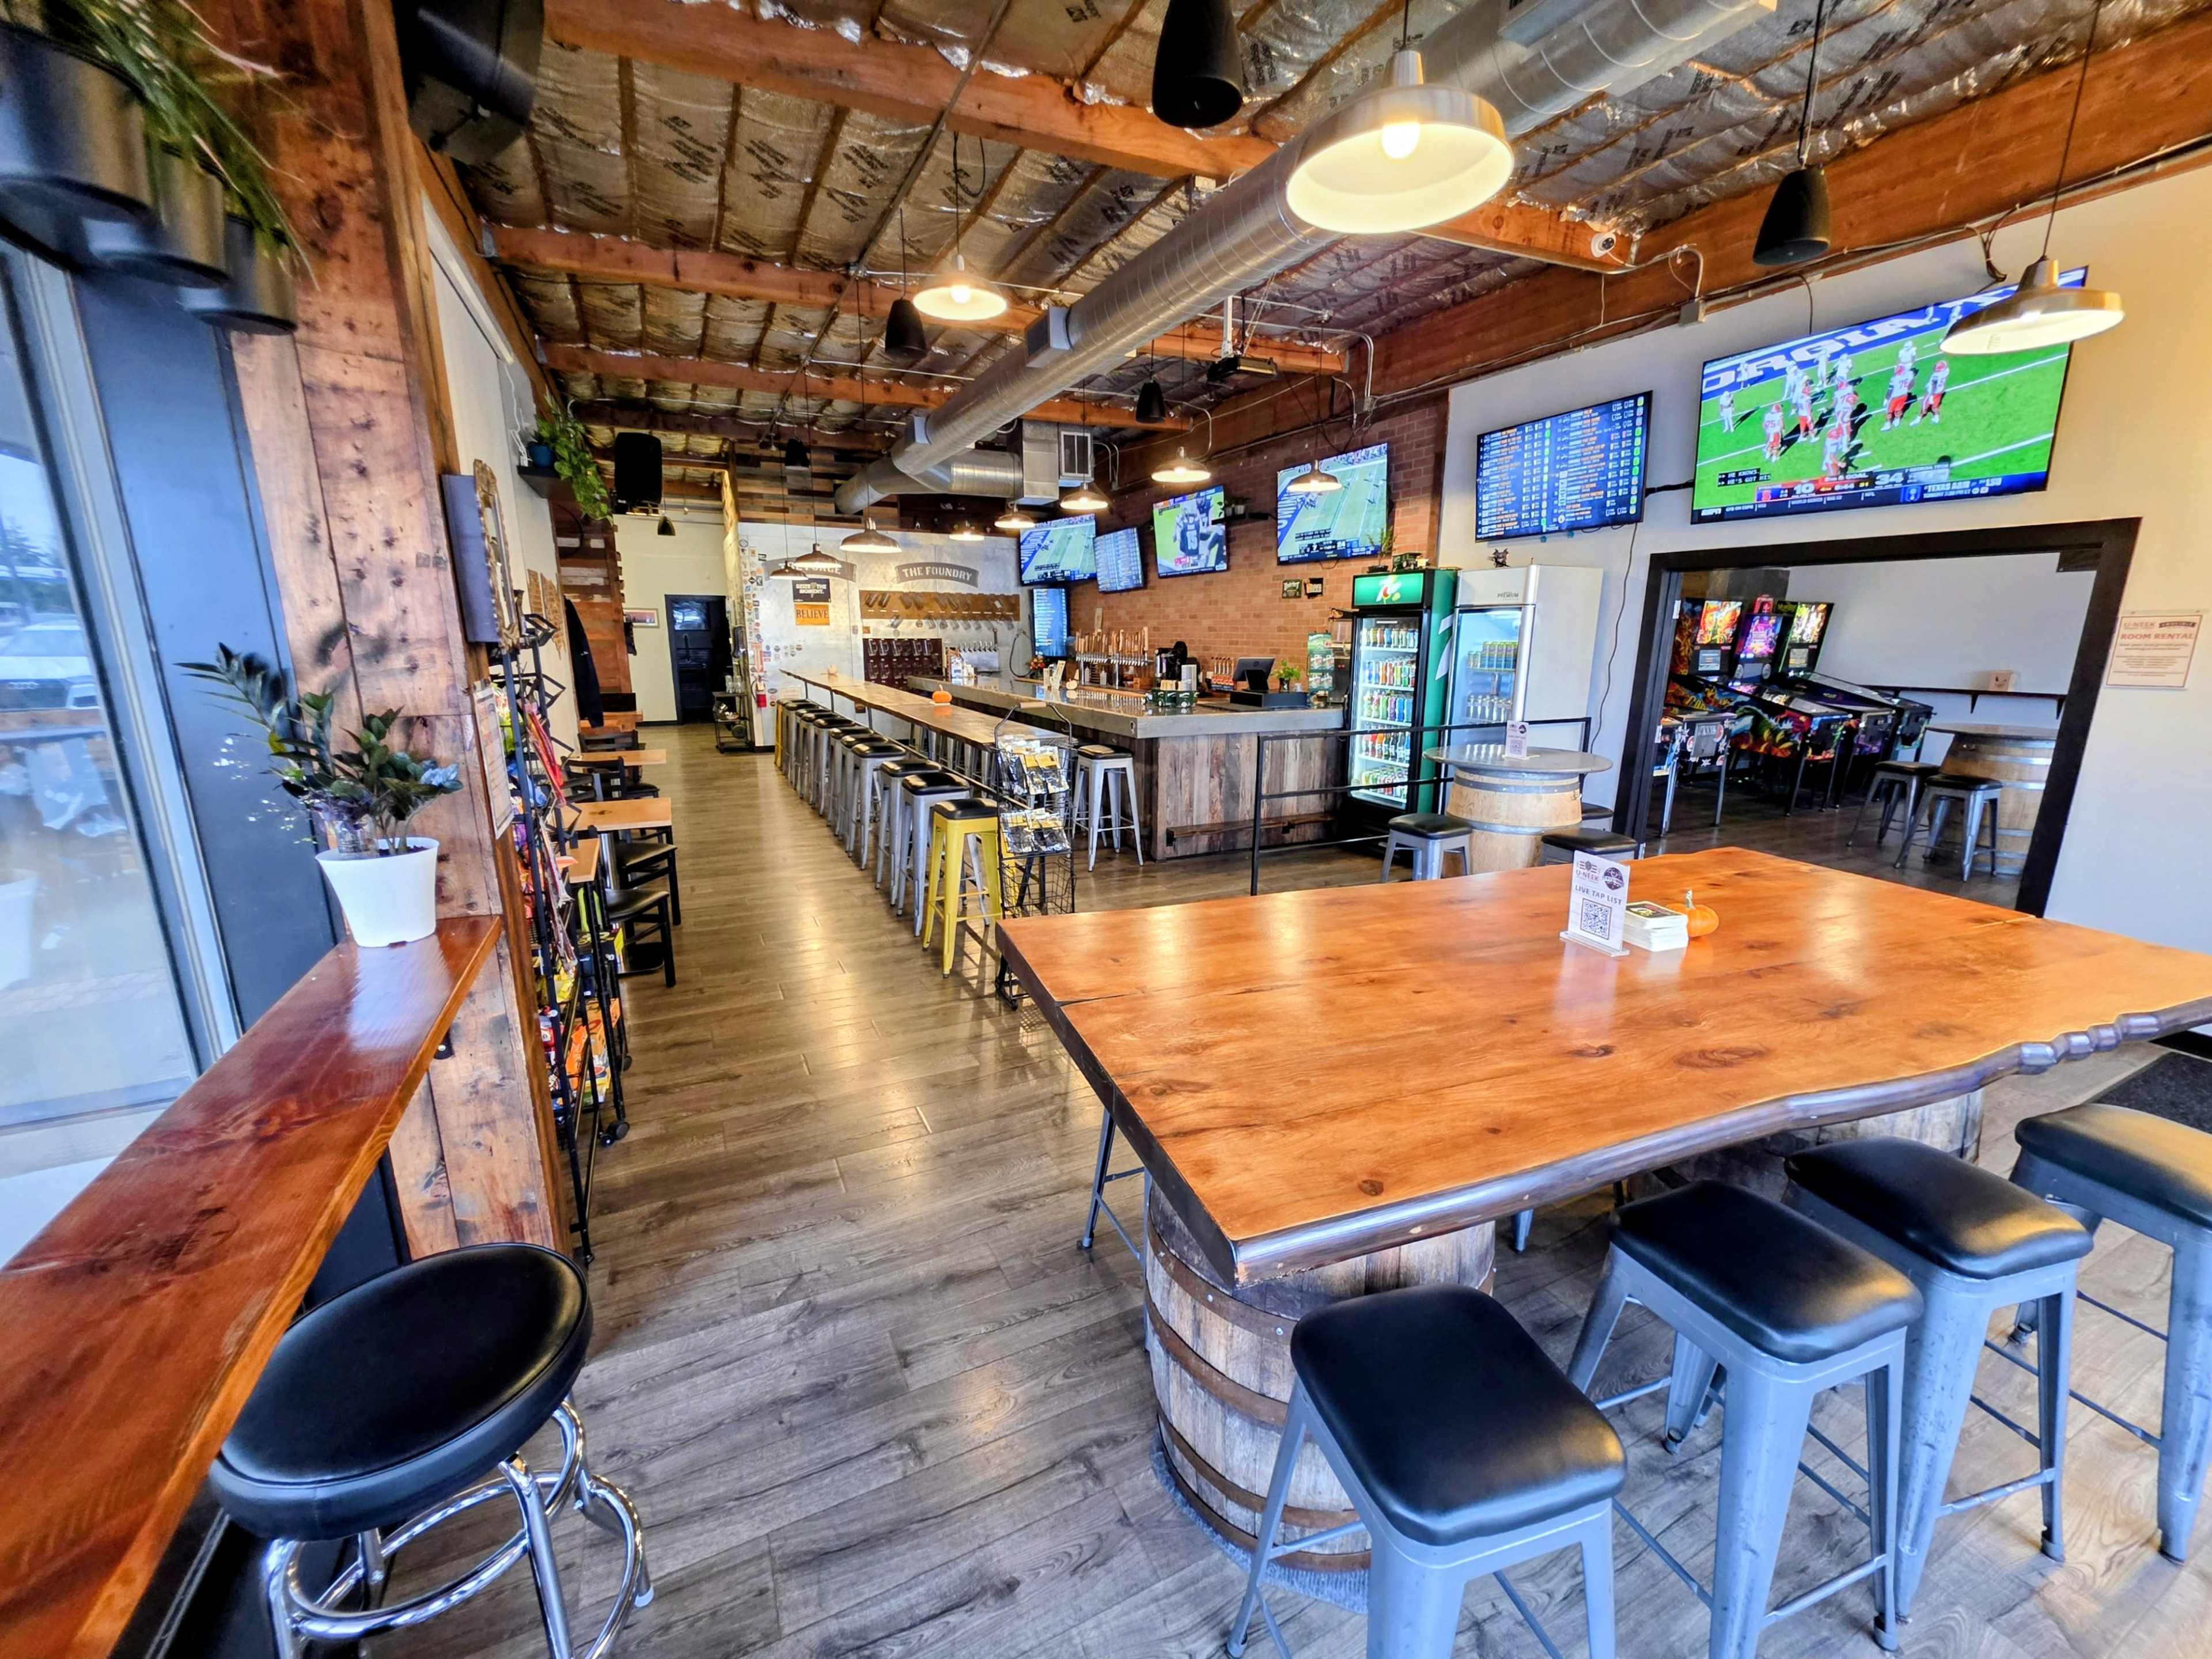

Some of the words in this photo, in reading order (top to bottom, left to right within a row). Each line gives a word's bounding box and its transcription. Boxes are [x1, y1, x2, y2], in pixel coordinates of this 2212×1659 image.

[1876, 472, 1904, 485] 34
[1793, 483, 1815, 494] 10
[1701, 508, 1721, 516] ESPN
[902, 567, 923, 577] THE
[925, 566, 972, 581] FOUNDRY
[797, 608, 829, 619] BELIEVE
[1576, 869, 1599, 881] U-NEEK
[1575, 884, 1590, 895] LIVE
[1592, 889, 1605, 899] TAP
[1607, 895, 1622, 905] LIST
